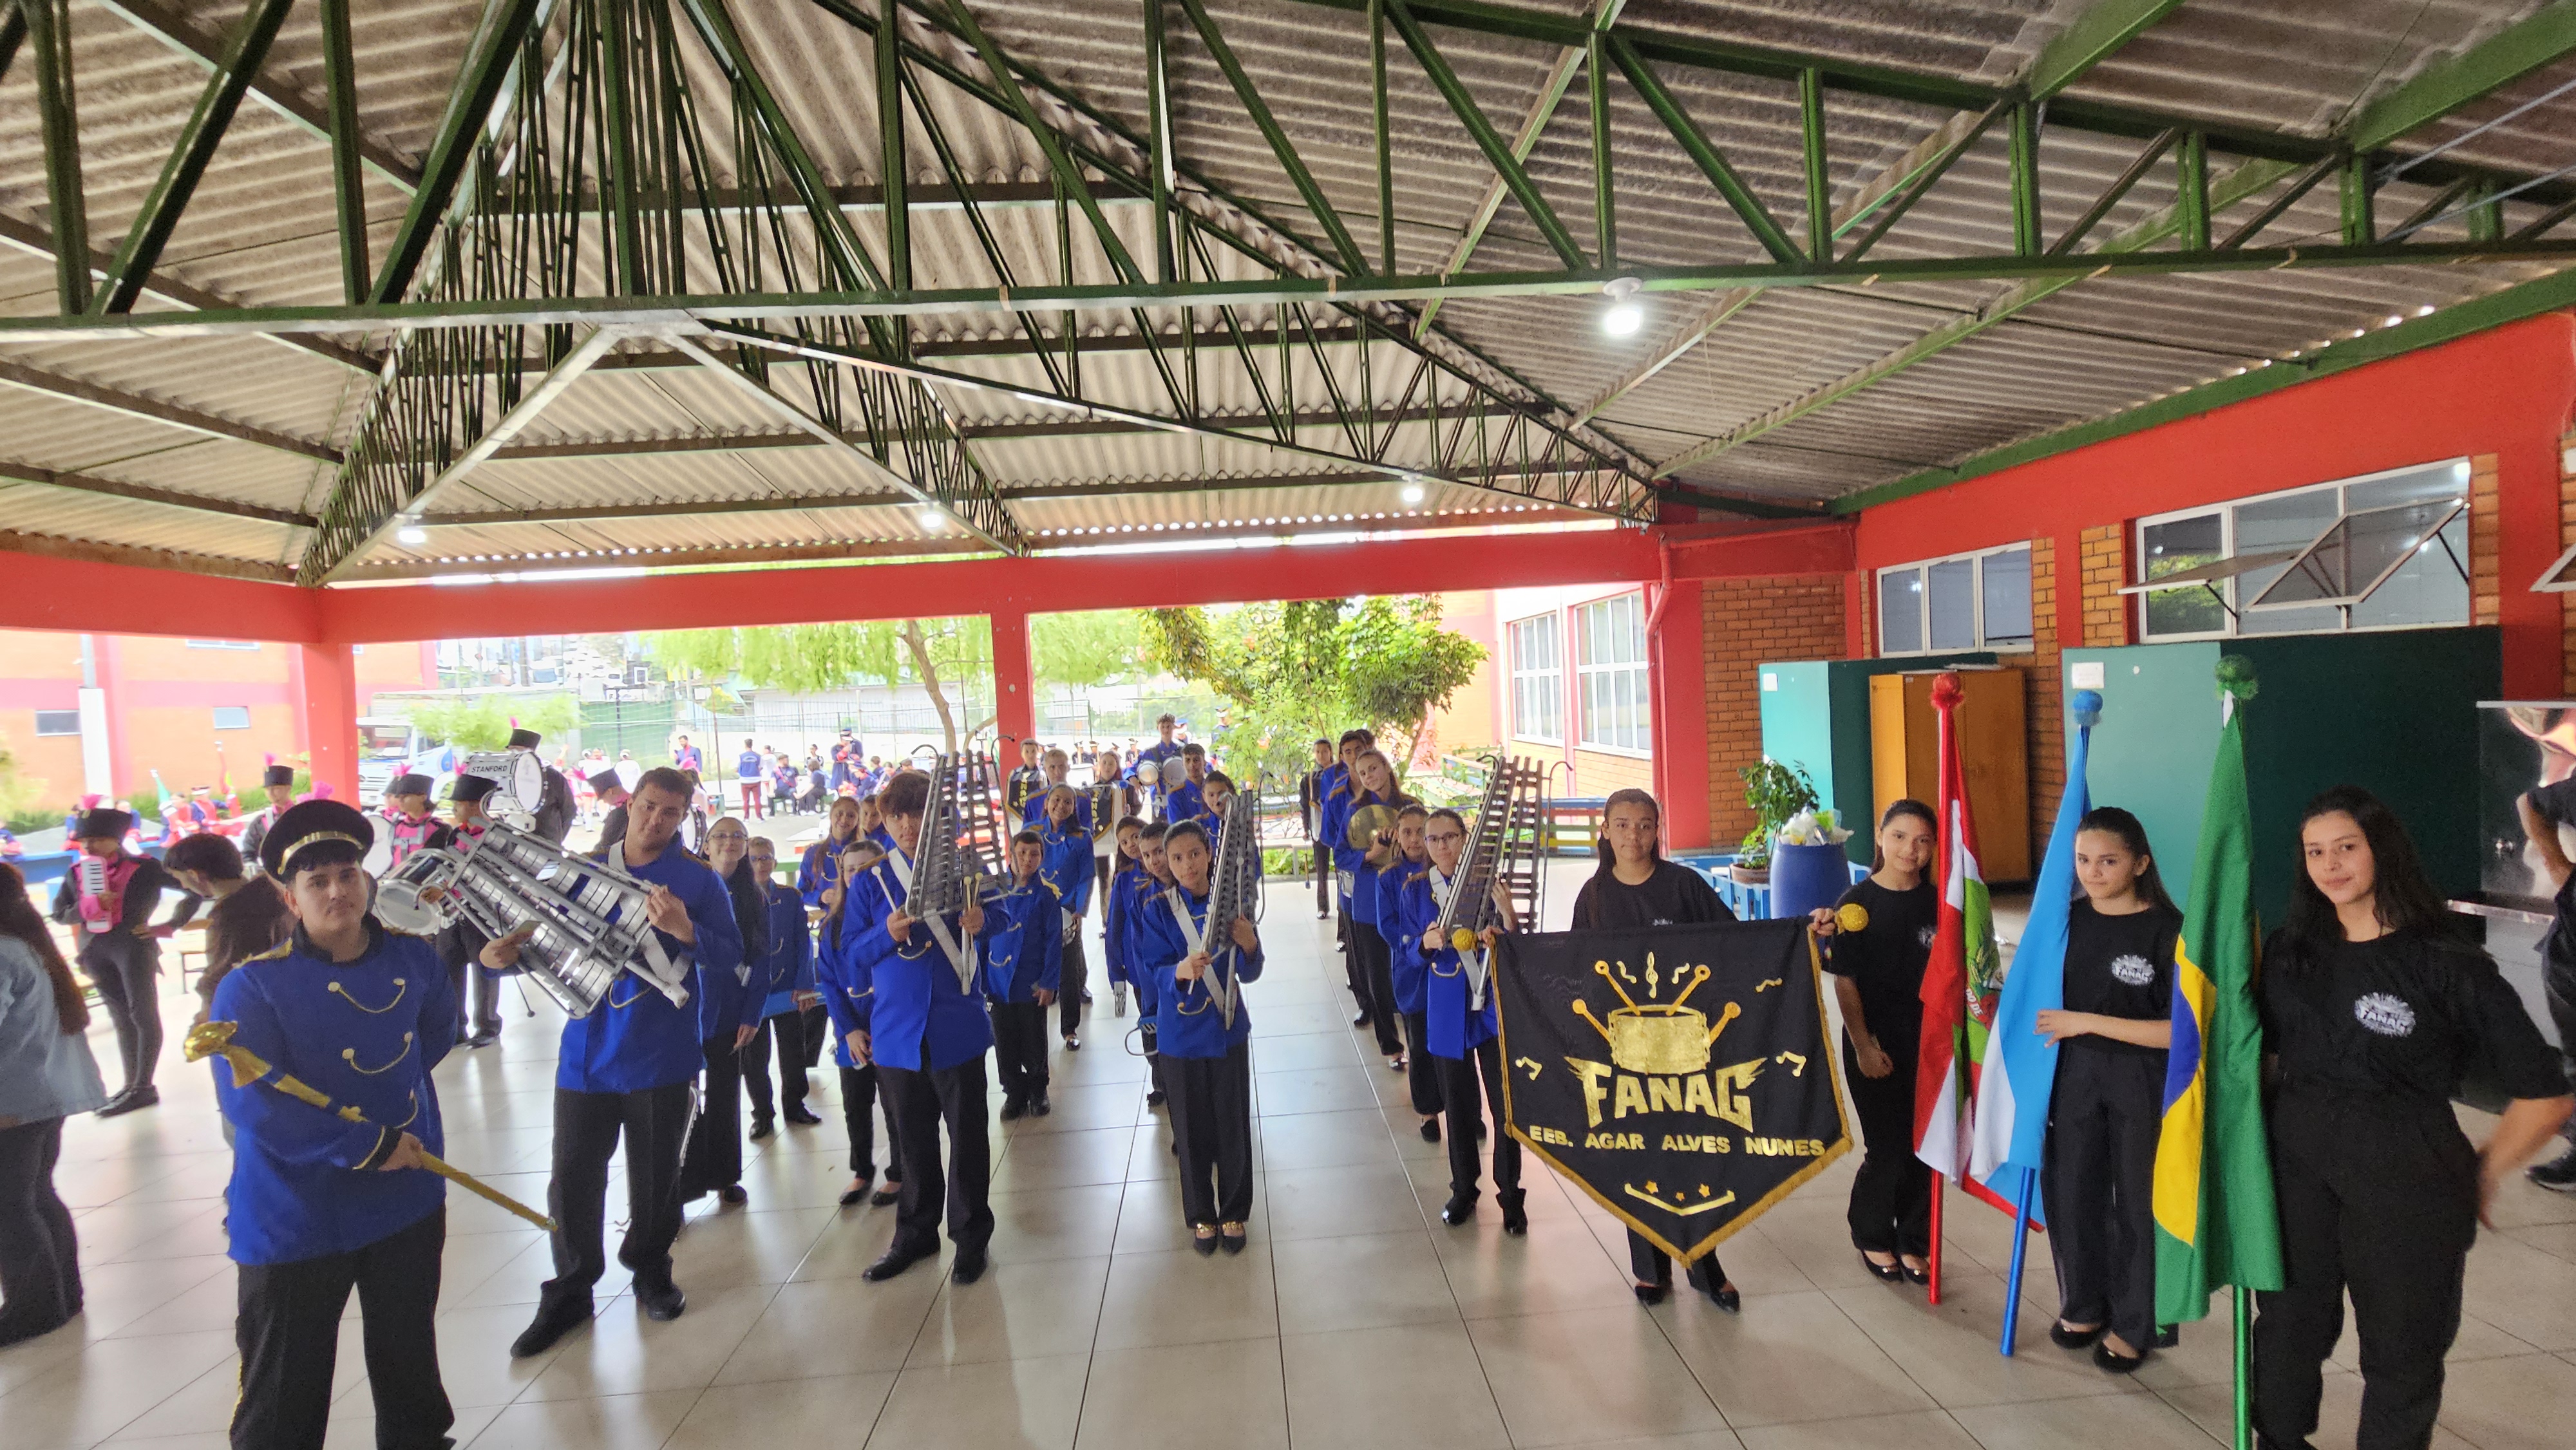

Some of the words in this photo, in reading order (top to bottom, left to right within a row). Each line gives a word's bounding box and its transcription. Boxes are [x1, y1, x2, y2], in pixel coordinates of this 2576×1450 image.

[471, 765, 508, 773] STANFORD
[2359, 1004, 2410, 1033] FANAG
[1563, 1056, 1768, 1133] FANAG
[1529, 1125, 1574, 1147] EEB.
[1584, 1132, 1645, 1150] AGAR
[1662, 1135, 1731, 1154] ALVES
[1745, 1136, 1826, 1156] NUNES
